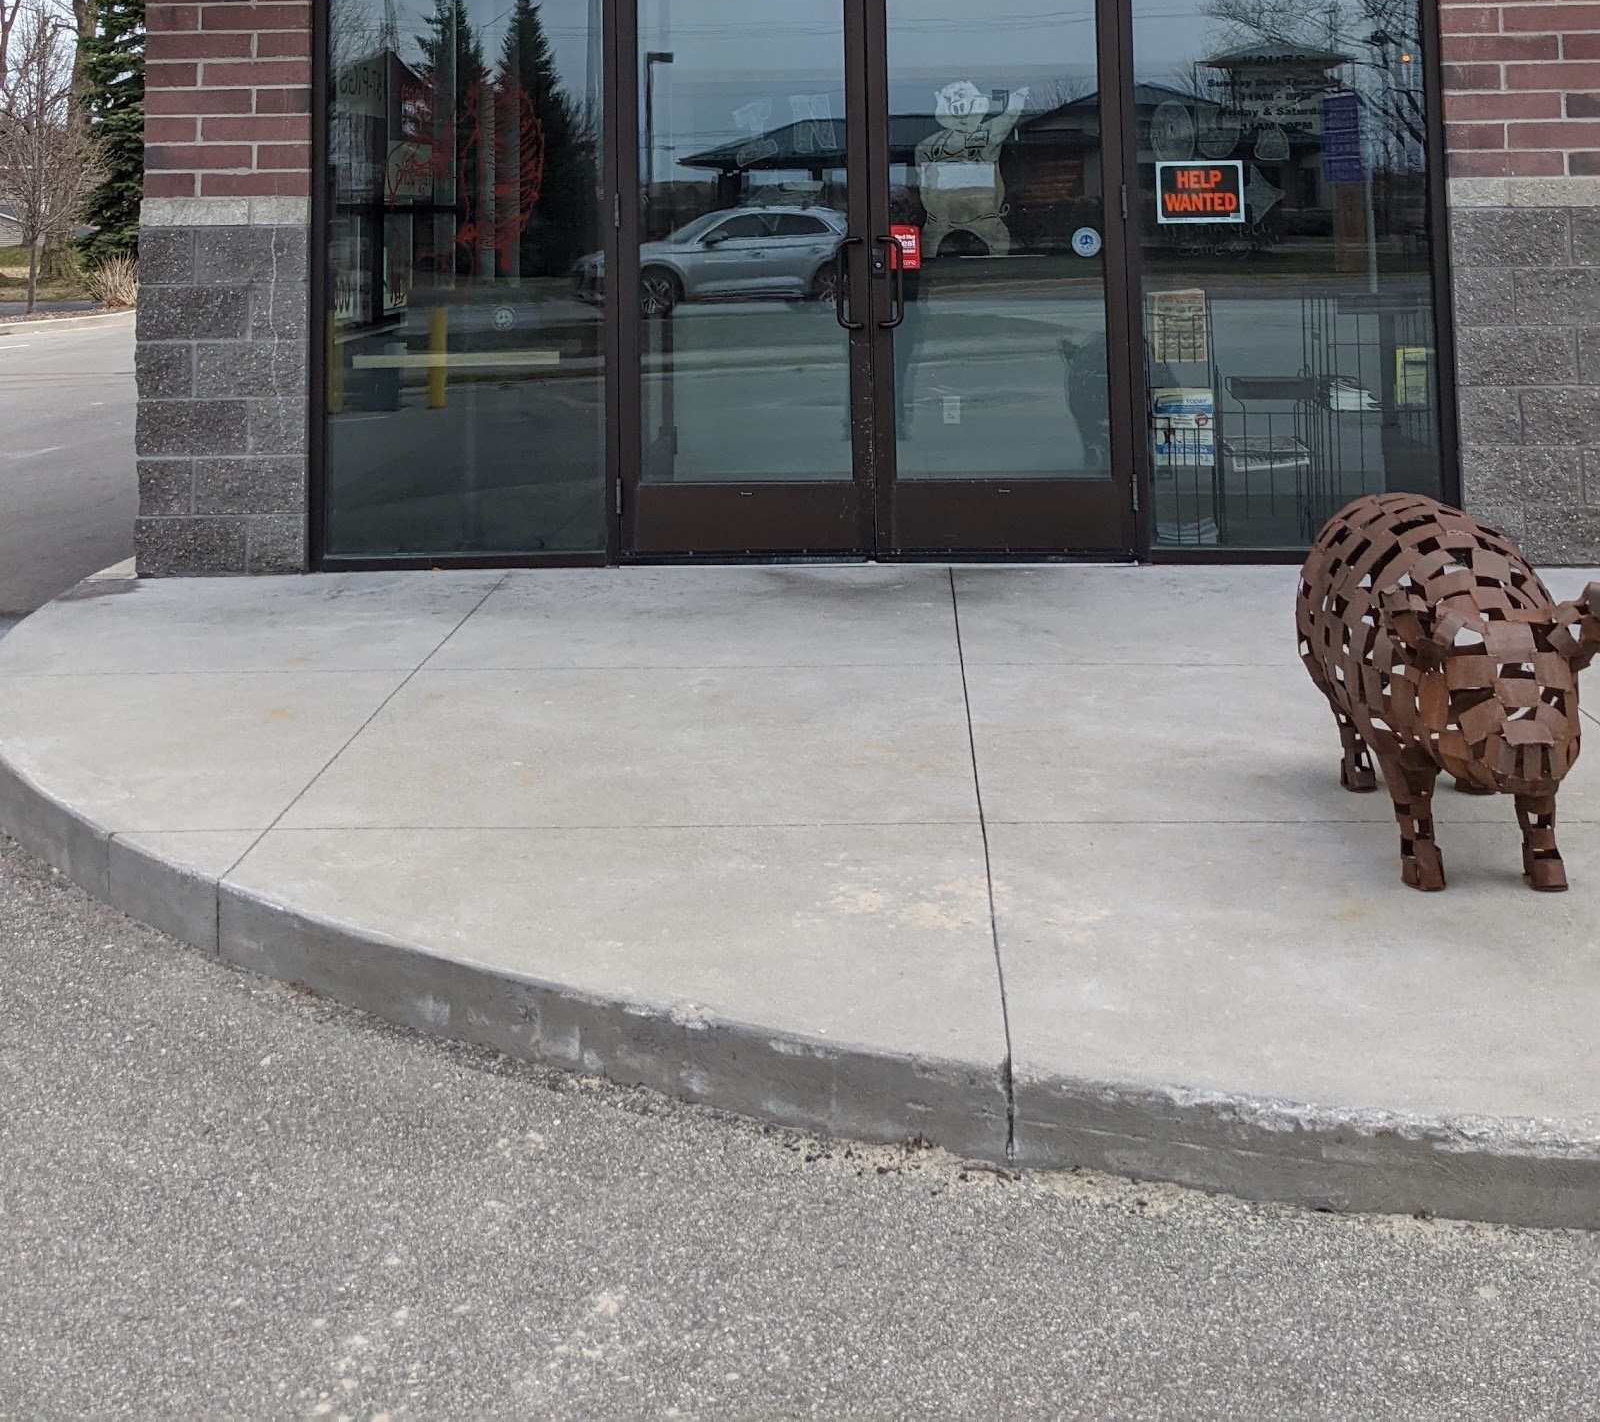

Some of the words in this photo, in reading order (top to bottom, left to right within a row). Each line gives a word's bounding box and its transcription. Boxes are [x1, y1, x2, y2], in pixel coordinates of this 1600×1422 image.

[1243, 54, 1306, 67] HOURS
[1176, 170, 1222, 189] HELP
[1164, 192, 1237, 211] WANTED
